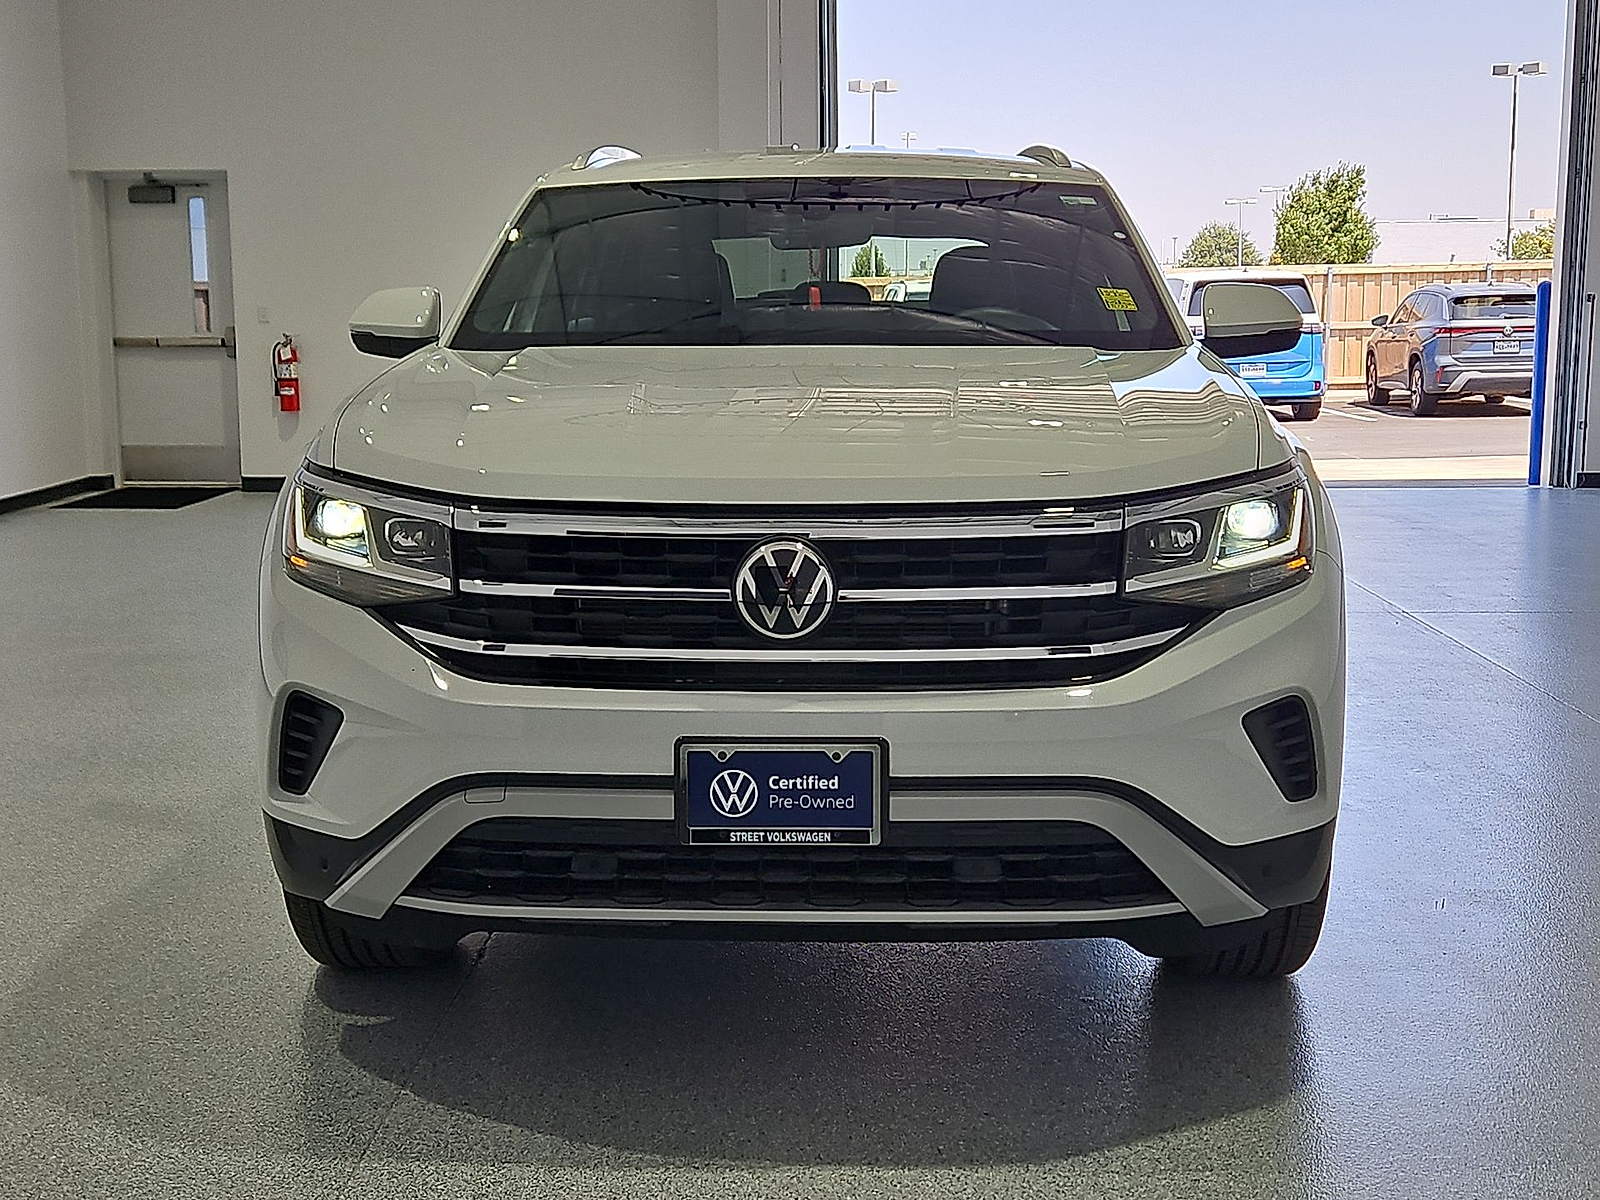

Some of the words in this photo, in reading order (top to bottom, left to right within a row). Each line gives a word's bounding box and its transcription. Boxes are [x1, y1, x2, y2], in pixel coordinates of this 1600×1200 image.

[768, 775, 839, 790] Certified
[769, 794, 855, 809] Pre-Owned
[729, 832, 765, 842] STREET
[767, 832, 831, 842] VOLKSWAGEN
